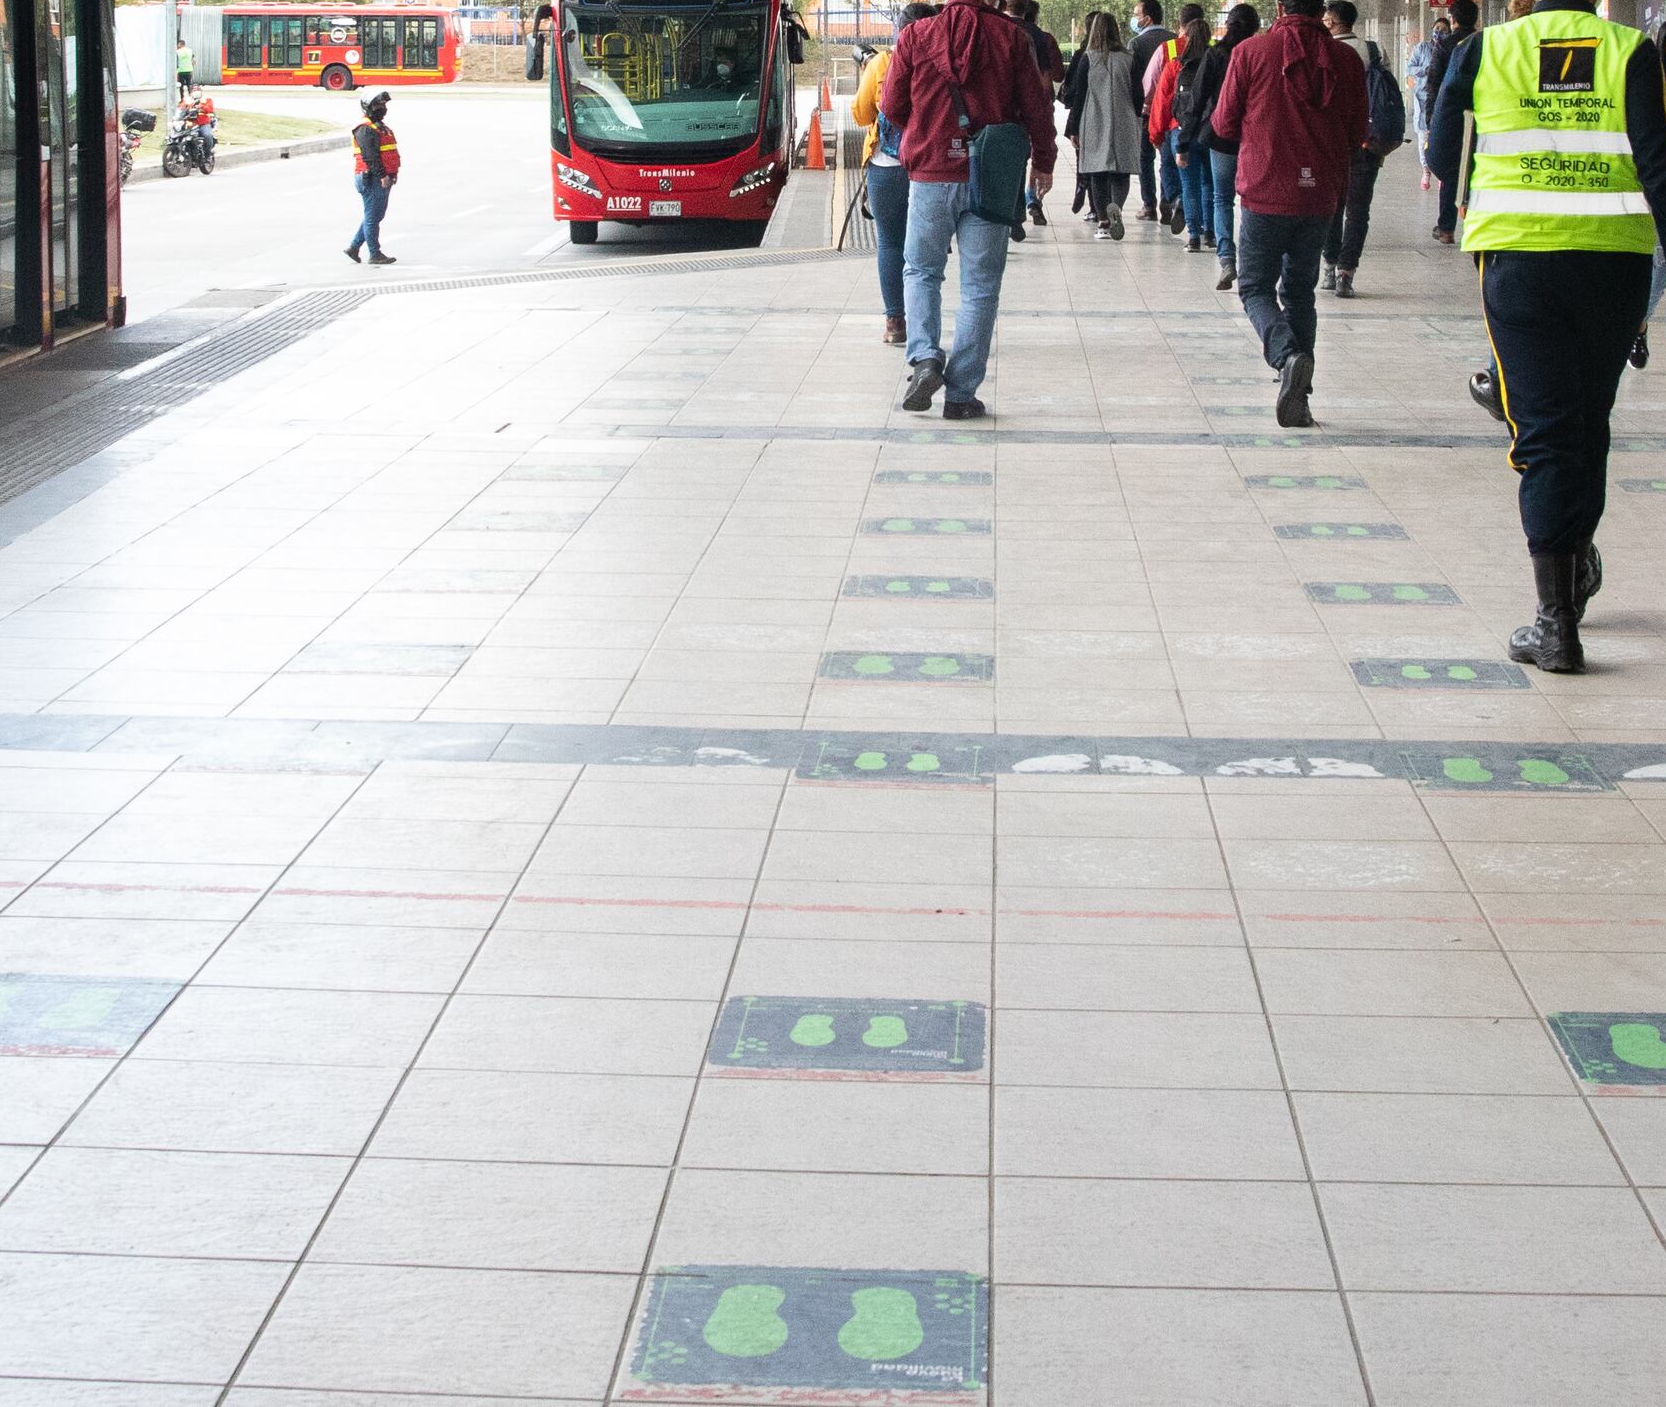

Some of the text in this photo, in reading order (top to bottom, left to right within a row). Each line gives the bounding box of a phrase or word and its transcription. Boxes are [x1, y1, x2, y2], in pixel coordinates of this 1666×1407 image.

[1542, 82, 1591, 92] TRANSMILENIO
[1519, 97, 1616, 109] UNION TEMPORAL
[1538, 111, 1563, 123] GOS
[1575, 111, 1600, 123] 2020
[1519, 157, 1611, 175] SEGURIDAD
[639, 168, 695, 178] TransMilenio
[1545, 175, 1576, 187] 2020
[606, 196, 641, 210] A1022
